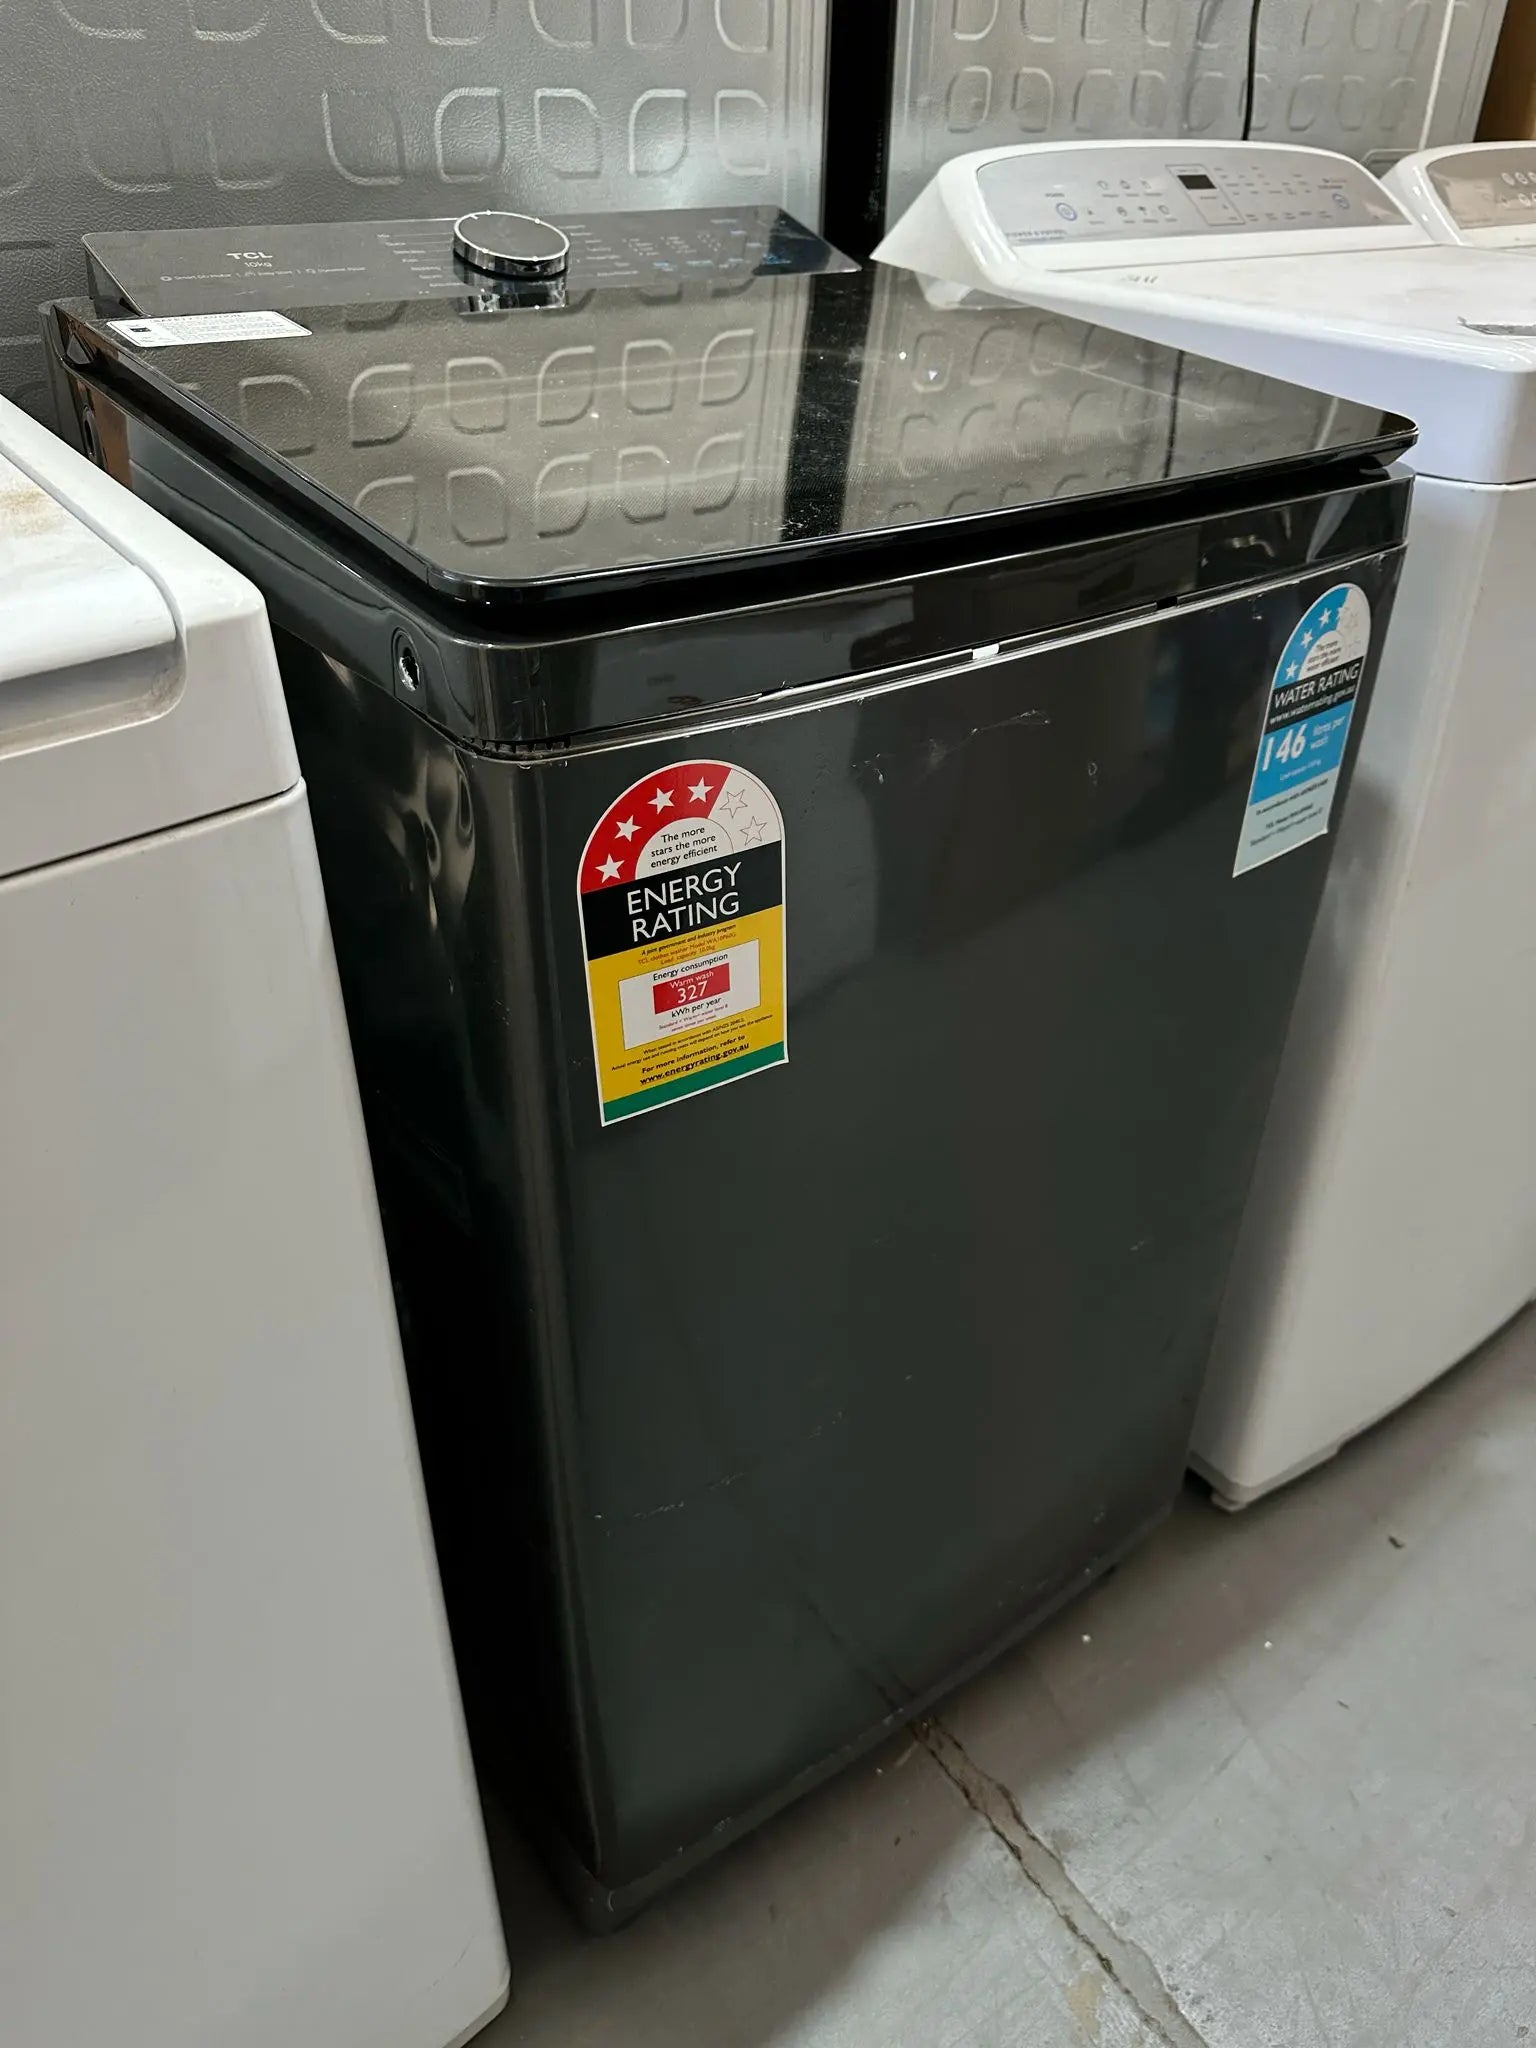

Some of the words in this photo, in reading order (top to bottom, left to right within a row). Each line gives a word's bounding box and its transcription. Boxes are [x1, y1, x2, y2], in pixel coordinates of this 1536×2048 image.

[1275, 680, 1316, 708] WATER
[1318, 663, 1360, 694] RATING
[1262, 723, 1308, 772] 146
[651, 846, 672, 857] stars
[676, 841, 690, 851] the
[693, 836, 716, 846] more
[661, 834, 678, 843] The
[682, 827, 705, 838] more
[651, 854, 680, 868] energy
[684, 846, 717, 860] efficient
[627, 862, 741, 915] ENERGY
[632, 892, 739, 942] RATING
[653, 966, 679, 982] Energy
[680, 952, 728, 973] consumption
[669, 976, 693, 989] Warm
[695, 969, 713, 981] wash
[677, 980, 708, 1003] 327
[671, 1006, 689, 1017] kWh
[691, 1002, 704, 1012] per
[706, 997, 721, 1008] year
[639, 1042, 749, 1085] www.energyrating.gov.au
[641, 1064, 654, 1073] For
[656, 1058, 674, 1068] more
[676, 1042, 718, 1062] information,
[720, 1037, 736, 1047] refer
